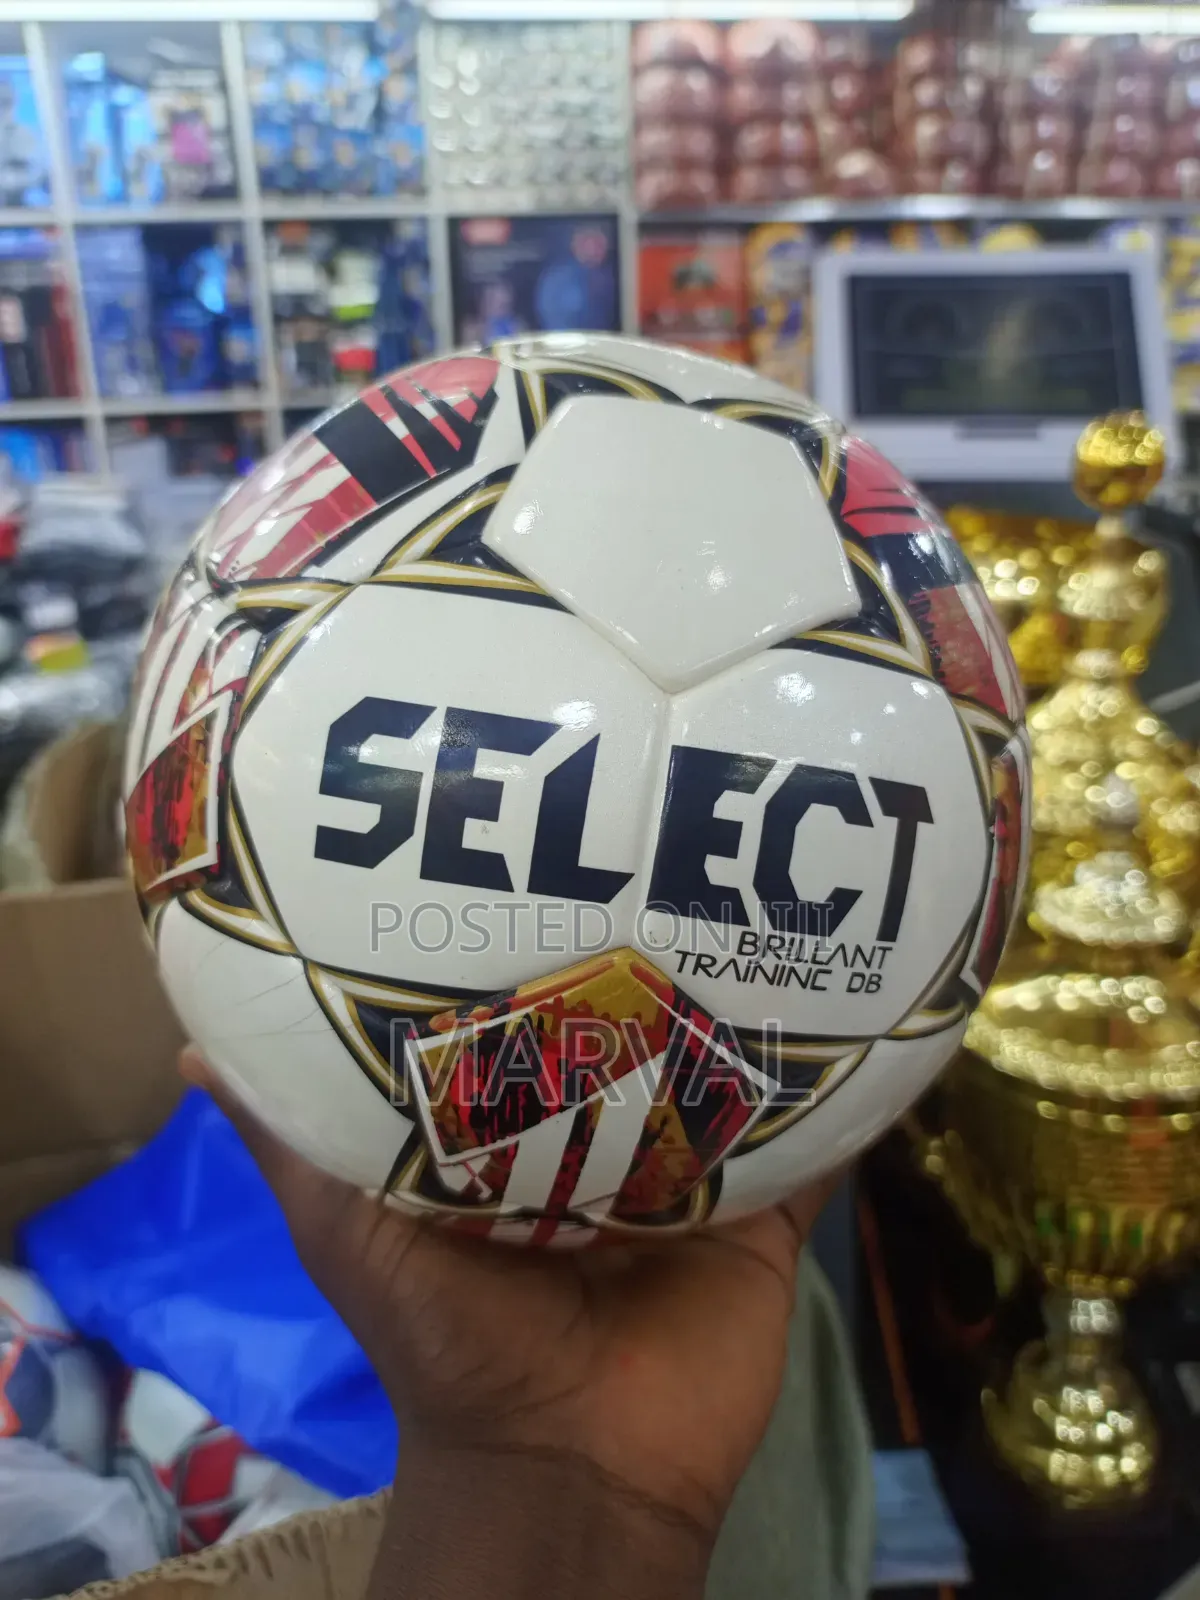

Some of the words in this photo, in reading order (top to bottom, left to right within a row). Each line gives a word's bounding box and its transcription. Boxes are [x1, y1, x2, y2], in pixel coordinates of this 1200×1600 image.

[314, 696, 934, 942] SELECT
[736, 930, 893, 970] BRILLANT
[846, 971, 883, 994] DB
